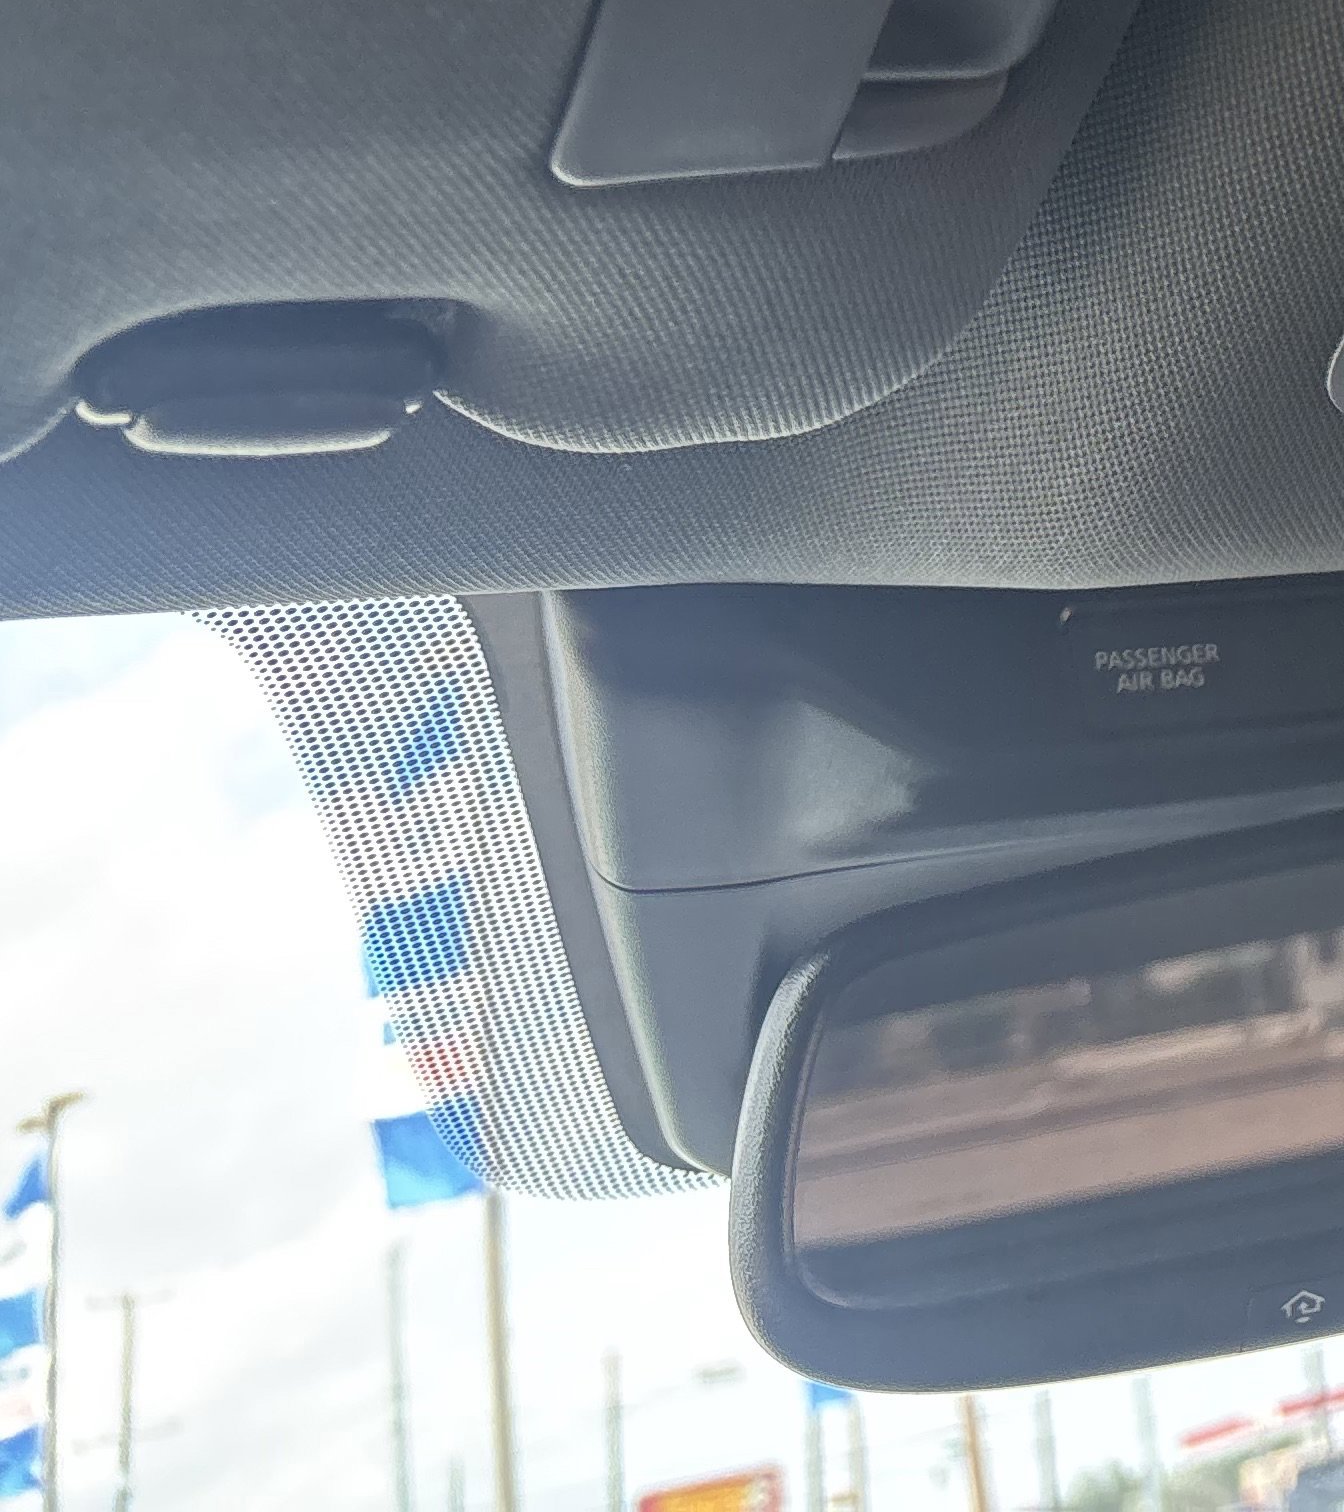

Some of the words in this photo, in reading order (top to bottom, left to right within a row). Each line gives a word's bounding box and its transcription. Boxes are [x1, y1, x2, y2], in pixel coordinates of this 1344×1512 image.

[1095, 643, 1220, 671] PASSENGER
[1116, 670, 1154, 694] AIR
[1161, 666, 1205, 690] BAG
